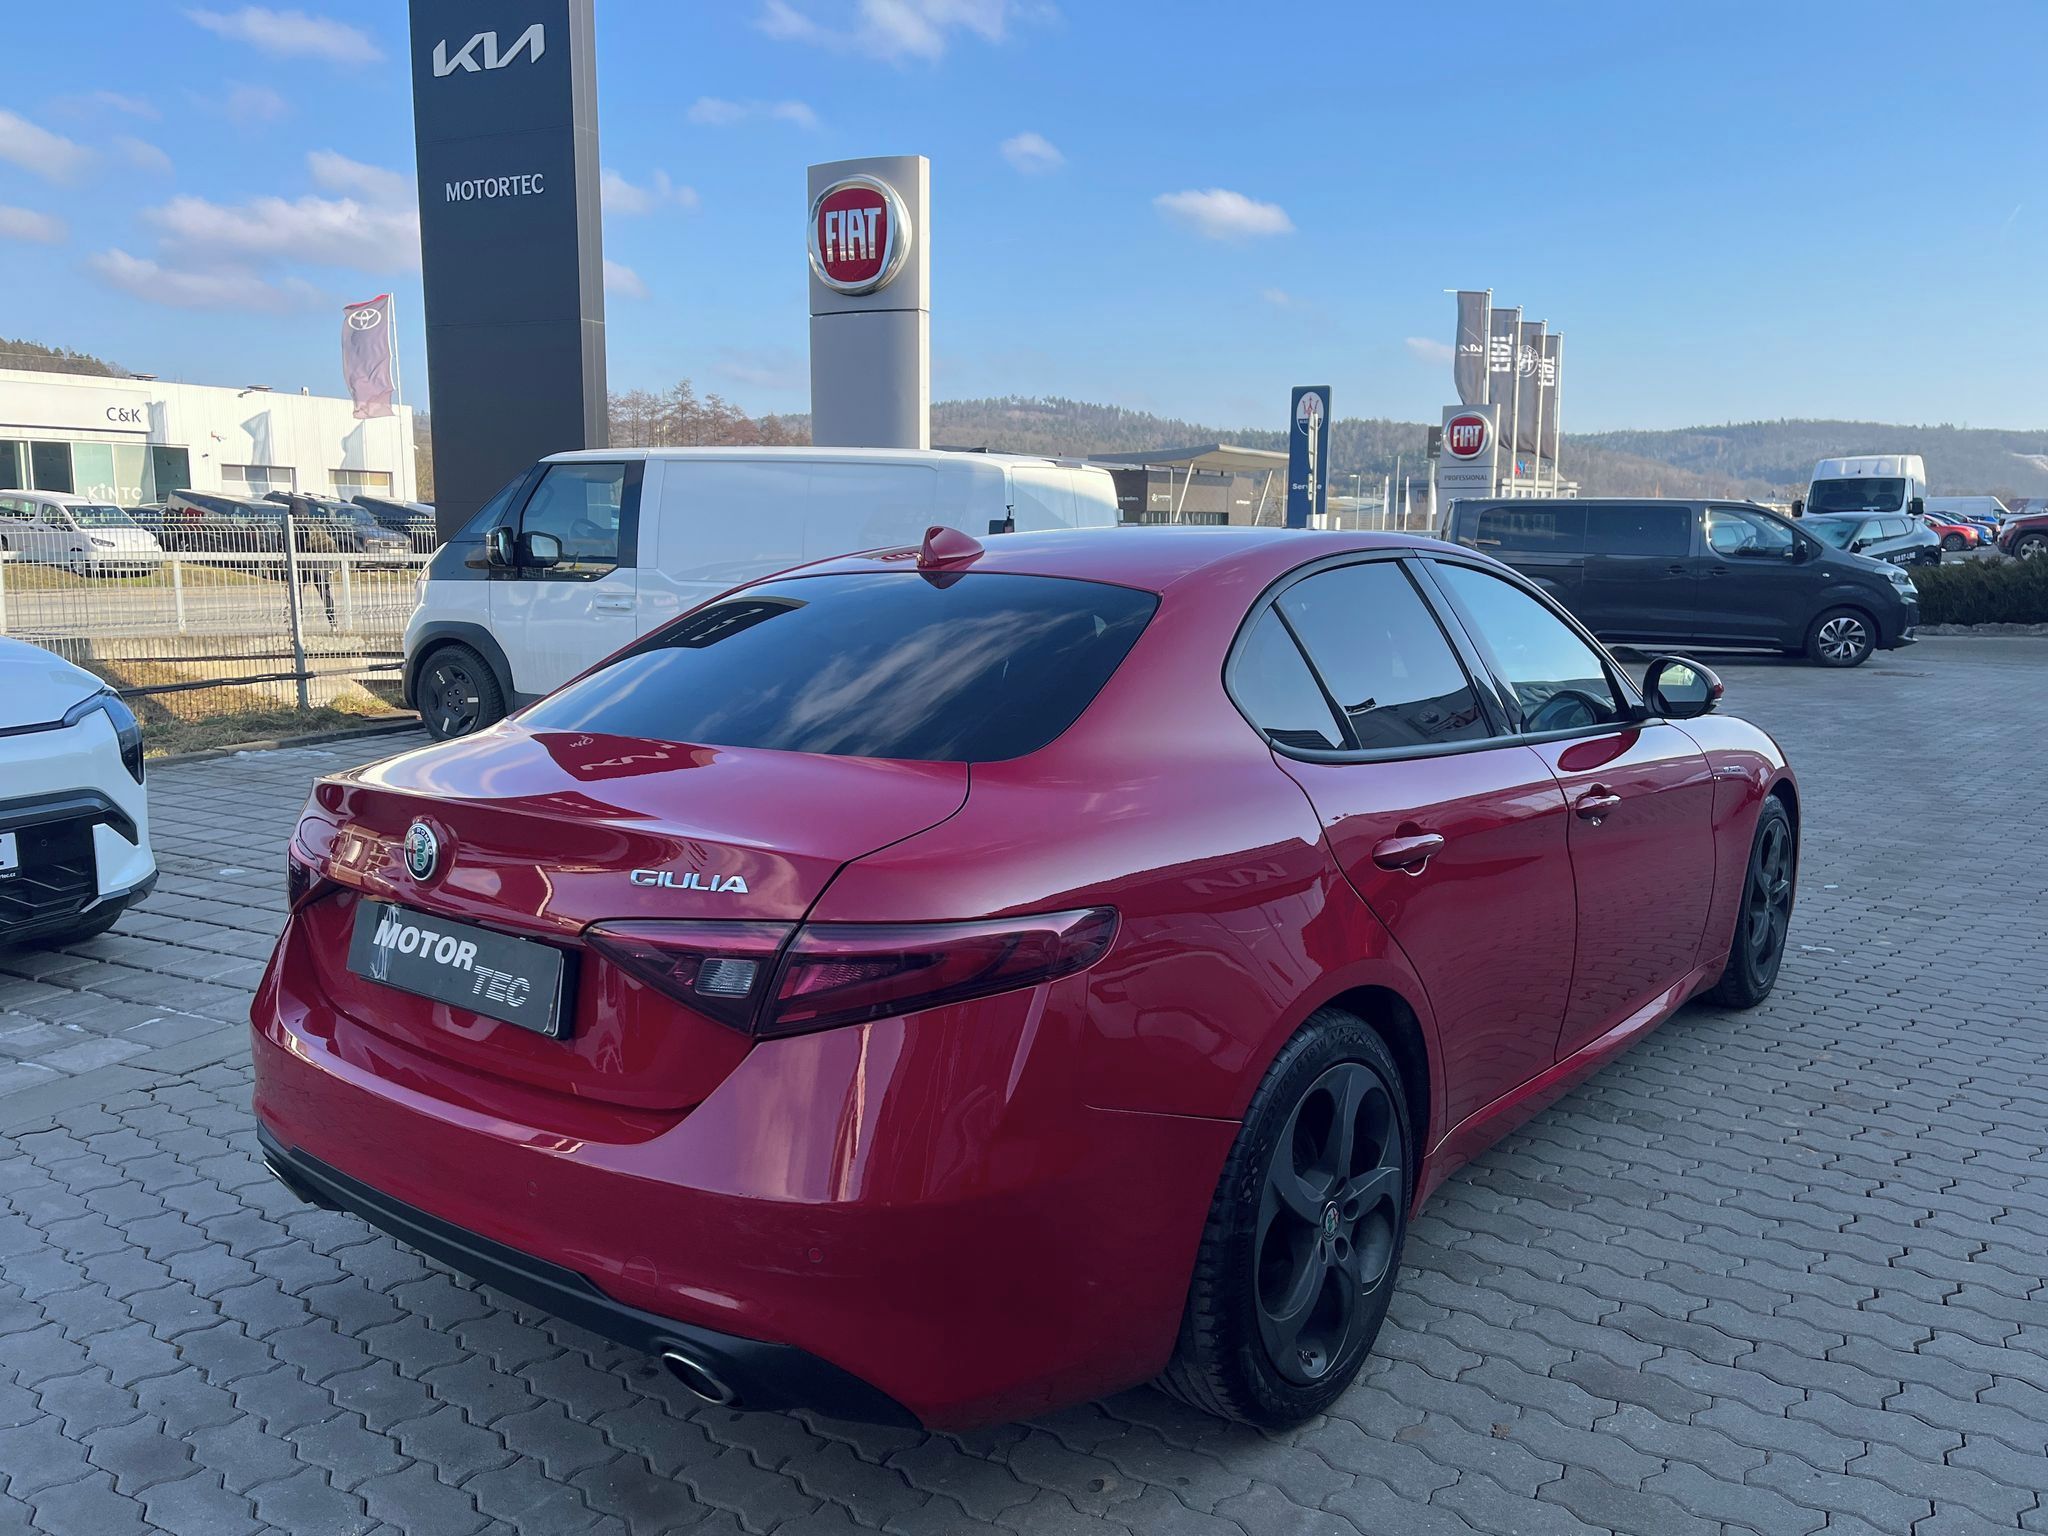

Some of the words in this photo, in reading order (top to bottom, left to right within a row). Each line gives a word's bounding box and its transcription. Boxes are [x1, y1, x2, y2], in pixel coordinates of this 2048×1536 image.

[432, 23, 546, 77] KIA
[445, 173, 544, 202] MOTORTEC
[825, 207, 882, 263] FIAT
[106, 406, 142, 423] C&K
[1453, 424, 1482, 448] FIAT
[630, 868, 749, 894] GIULIA
[372, 918, 478, 972] MOTOR
[471, 964, 531, 1009] TEC
